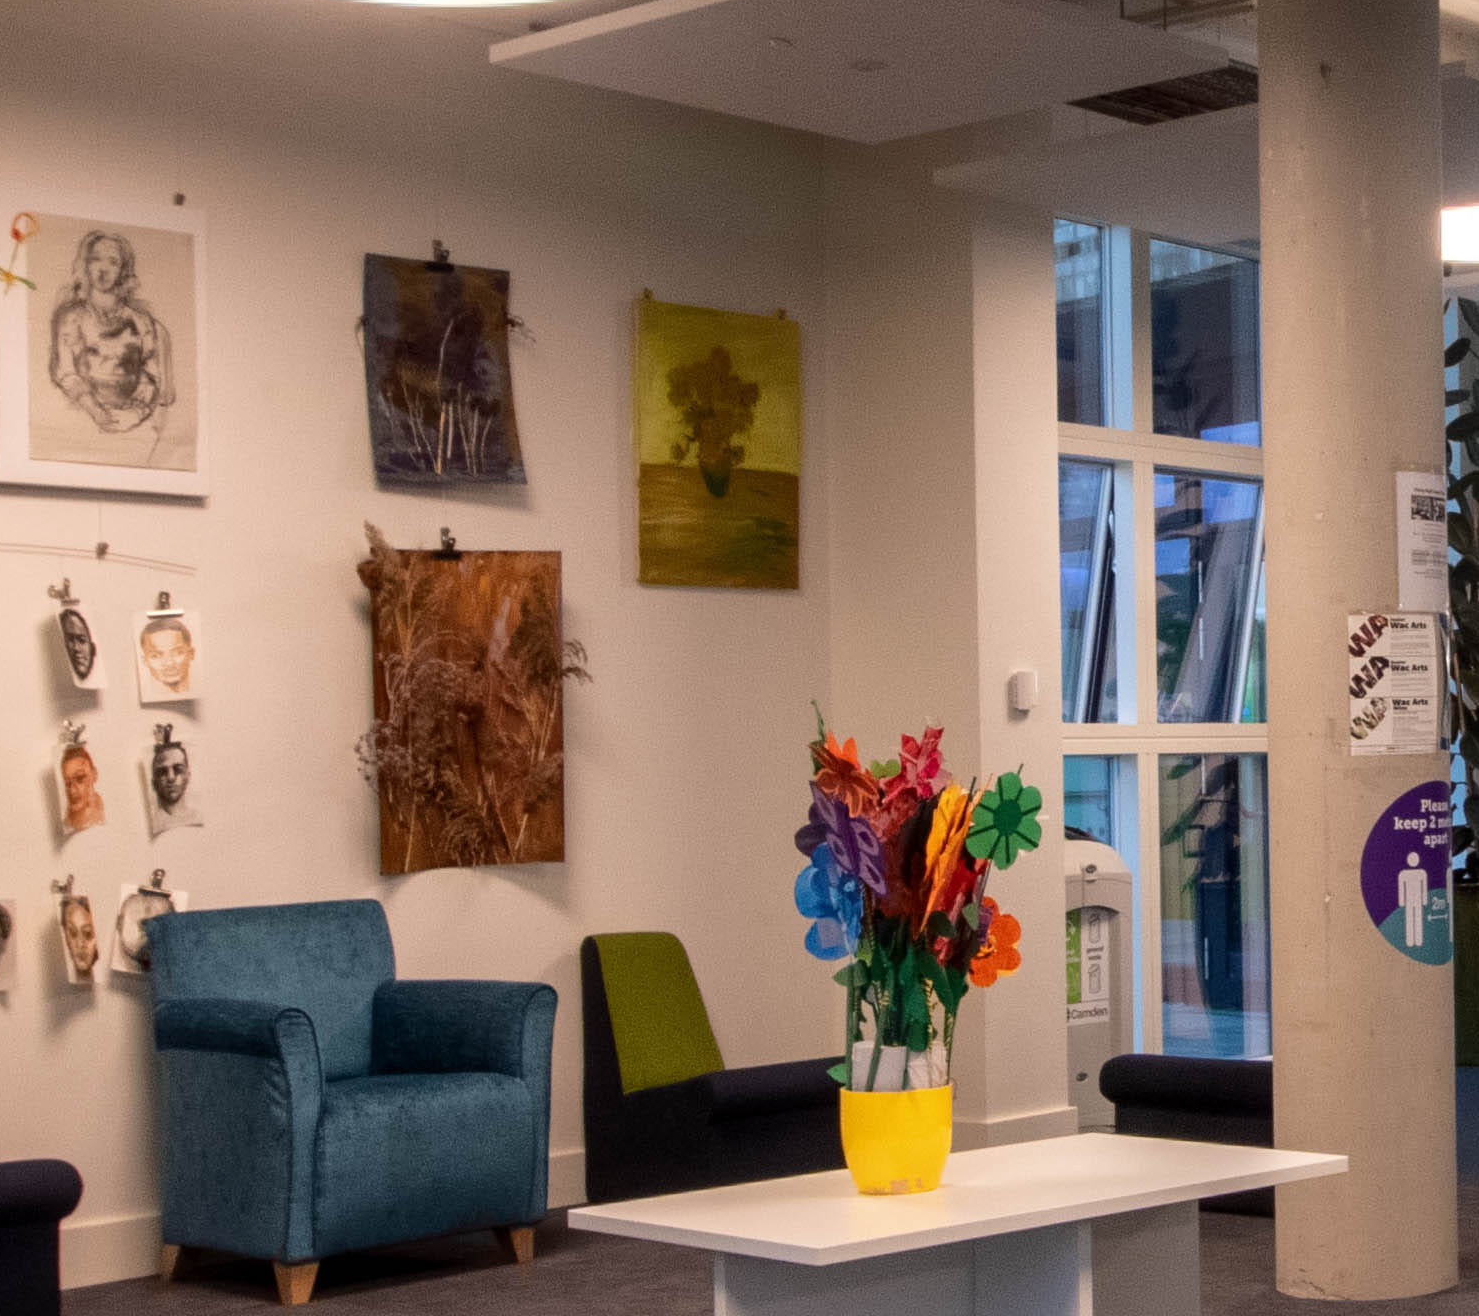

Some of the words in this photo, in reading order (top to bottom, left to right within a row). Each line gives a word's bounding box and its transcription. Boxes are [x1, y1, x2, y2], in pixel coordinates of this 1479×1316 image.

[1394, 816, 1427, 832] keep
[1429, 815, 1436, 829] 2
[1432, 896, 1446, 910] 2m
[1071, 1007, 1108, 1020] Camden
